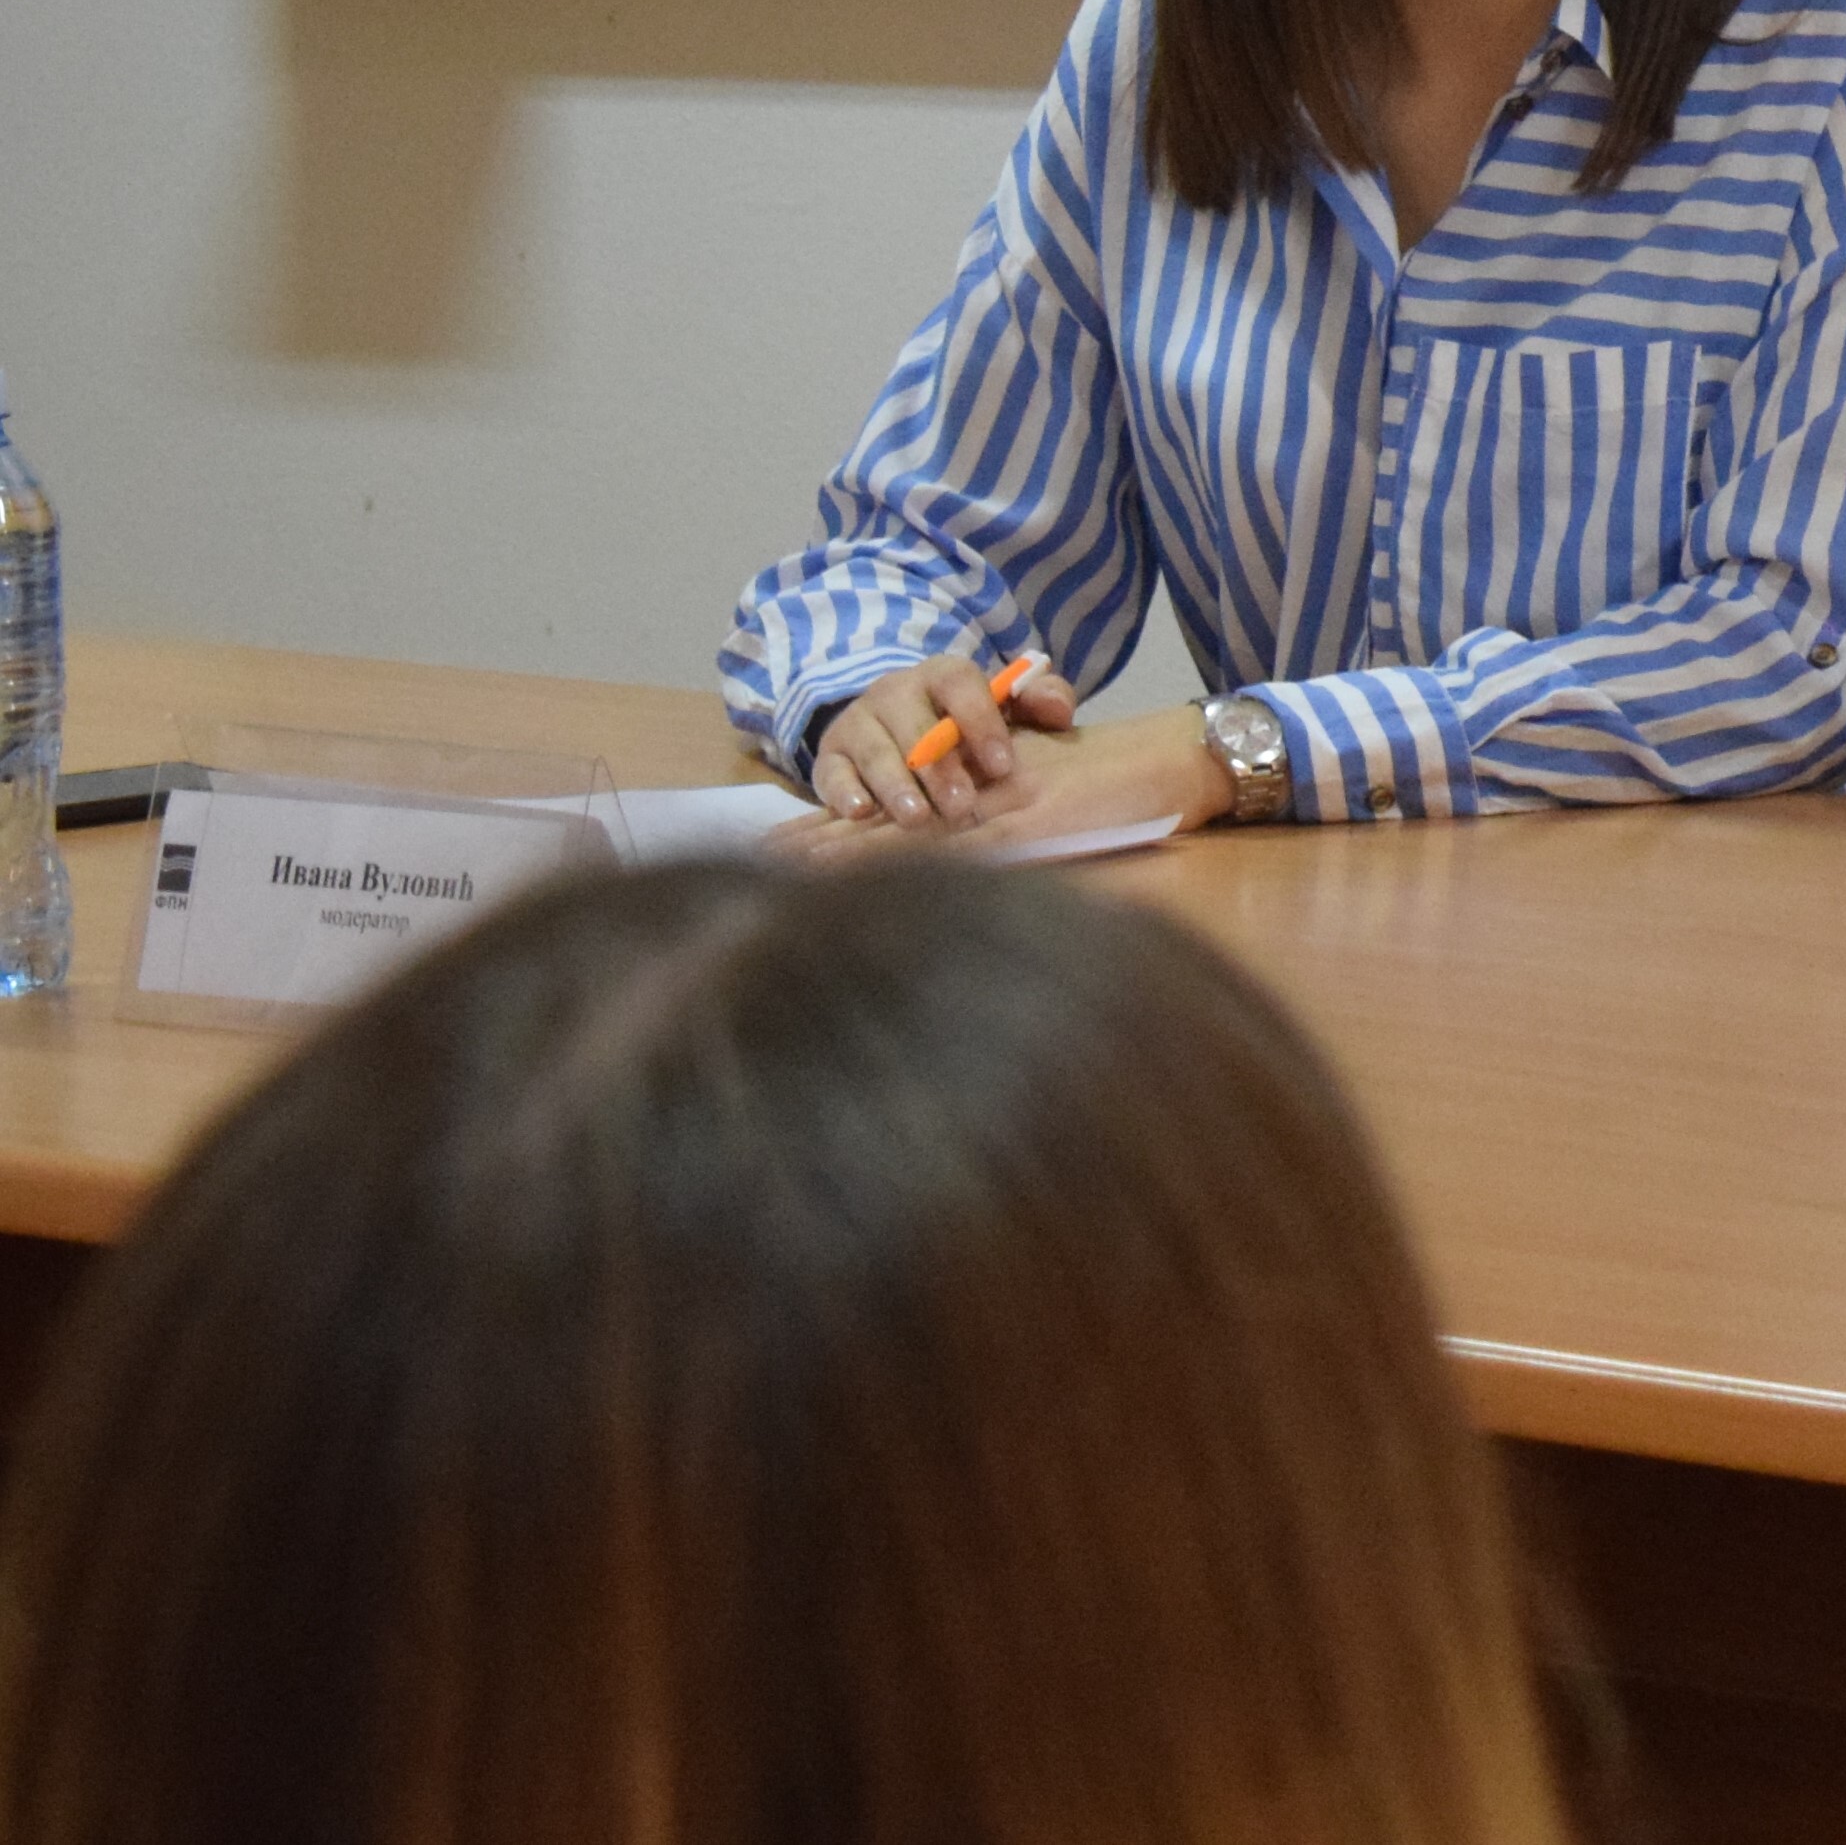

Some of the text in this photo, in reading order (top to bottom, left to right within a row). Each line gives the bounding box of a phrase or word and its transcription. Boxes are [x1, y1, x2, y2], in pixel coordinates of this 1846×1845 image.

[271, 855, 475, 902] Ивана Вуловић
[155, 895, 189, 911] ФПН
